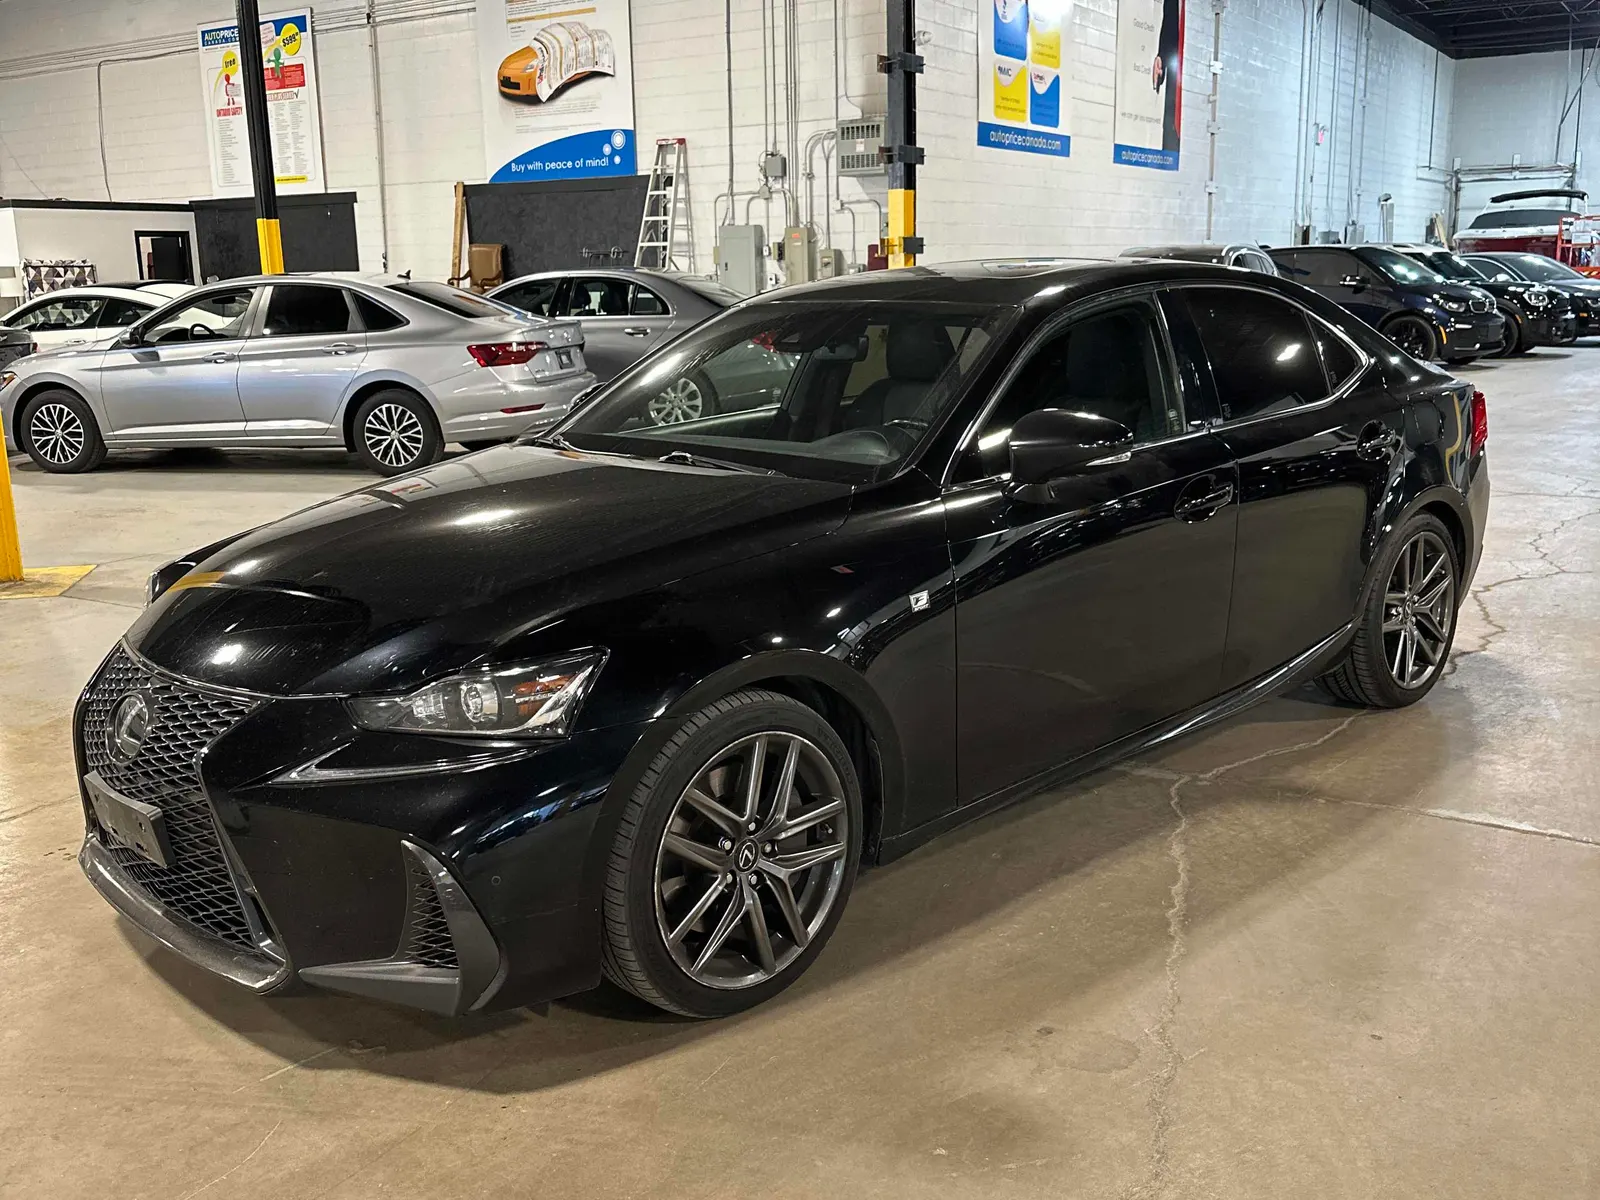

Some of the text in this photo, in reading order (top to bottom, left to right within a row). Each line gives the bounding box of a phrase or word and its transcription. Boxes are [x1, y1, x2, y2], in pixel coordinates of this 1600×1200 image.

[204, 28, 239, 41] AUTOPRICE
[989, 130, 1061, 150] autopricecanada.com
[511, 157, 609, 173] Buy with peace of mind!
[1121, 150, 1173, 165] autopricecanada.com
